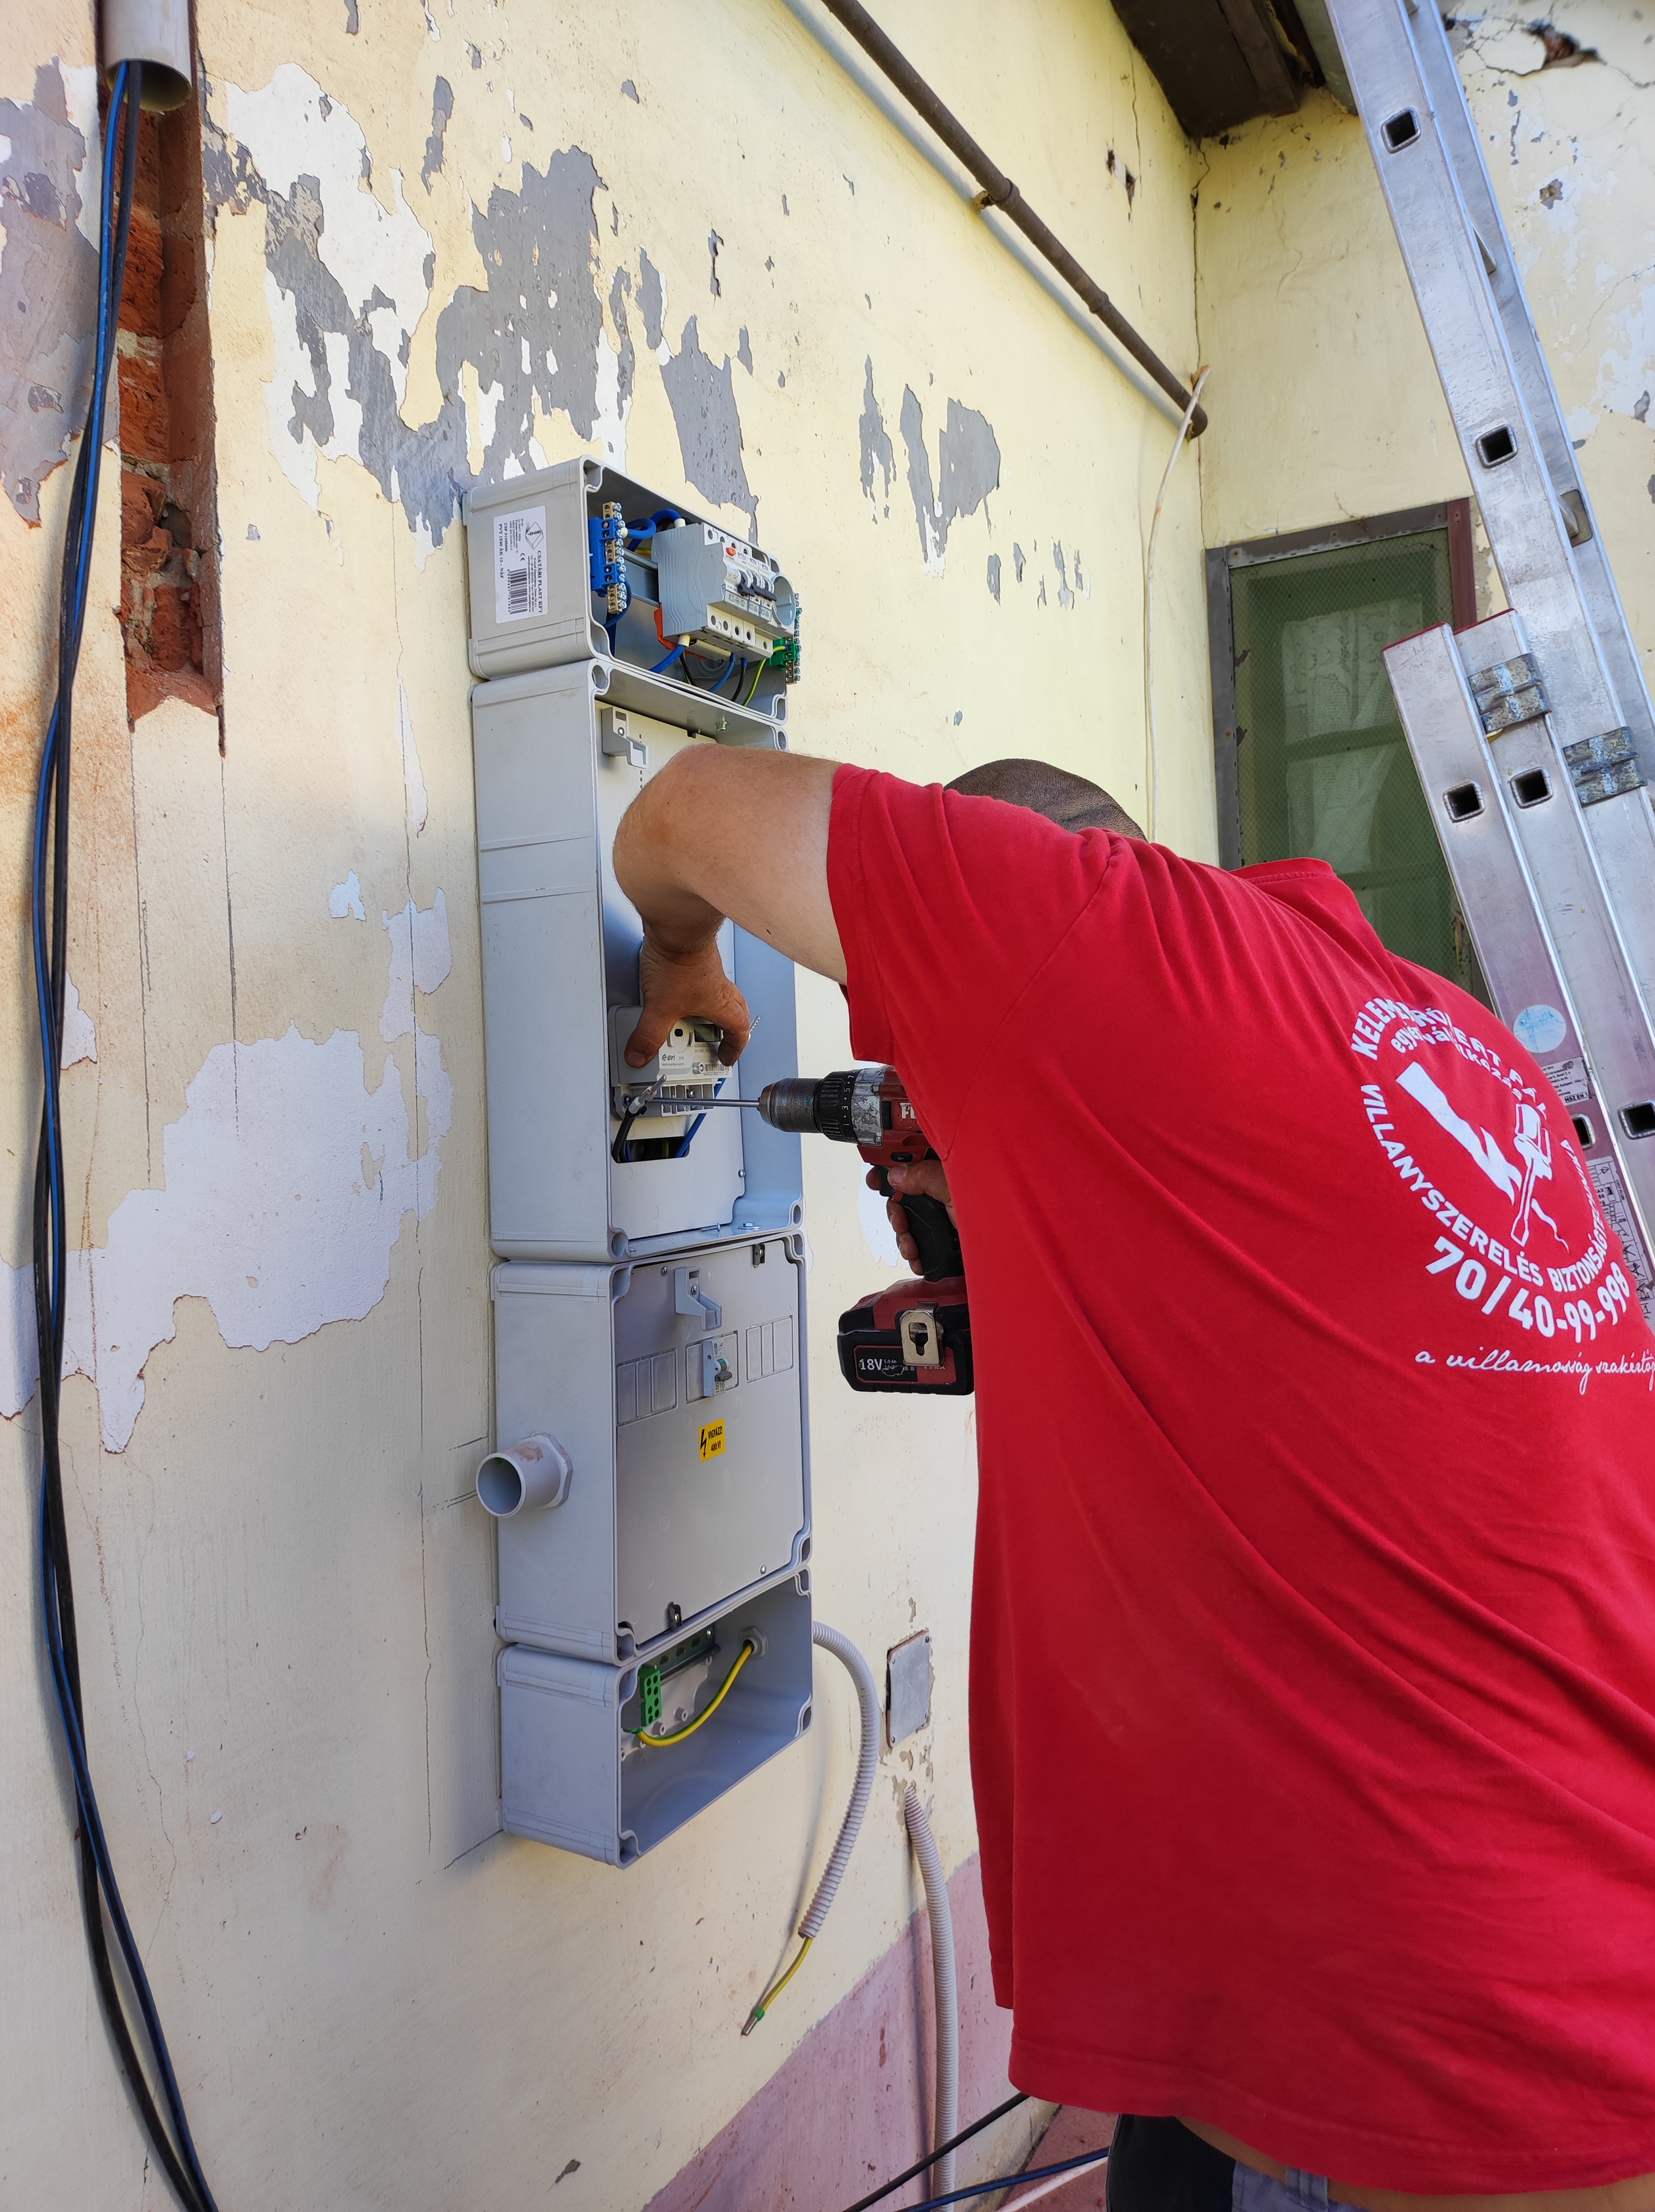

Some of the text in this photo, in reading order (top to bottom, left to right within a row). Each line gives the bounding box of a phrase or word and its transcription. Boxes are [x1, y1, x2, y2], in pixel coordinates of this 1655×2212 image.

[1360, 1085, 1543, 1287] VILLANYSZERELÉS
[858, 1358, 882, 1371] 18V
[1415, 1351, 1436, 1364] a
[1446, 1346, 1594, 1395] villamosság
[715, 1381, 725, 1391] B16
[708, 1425, 723, 1440] VIGYÁZZ!
